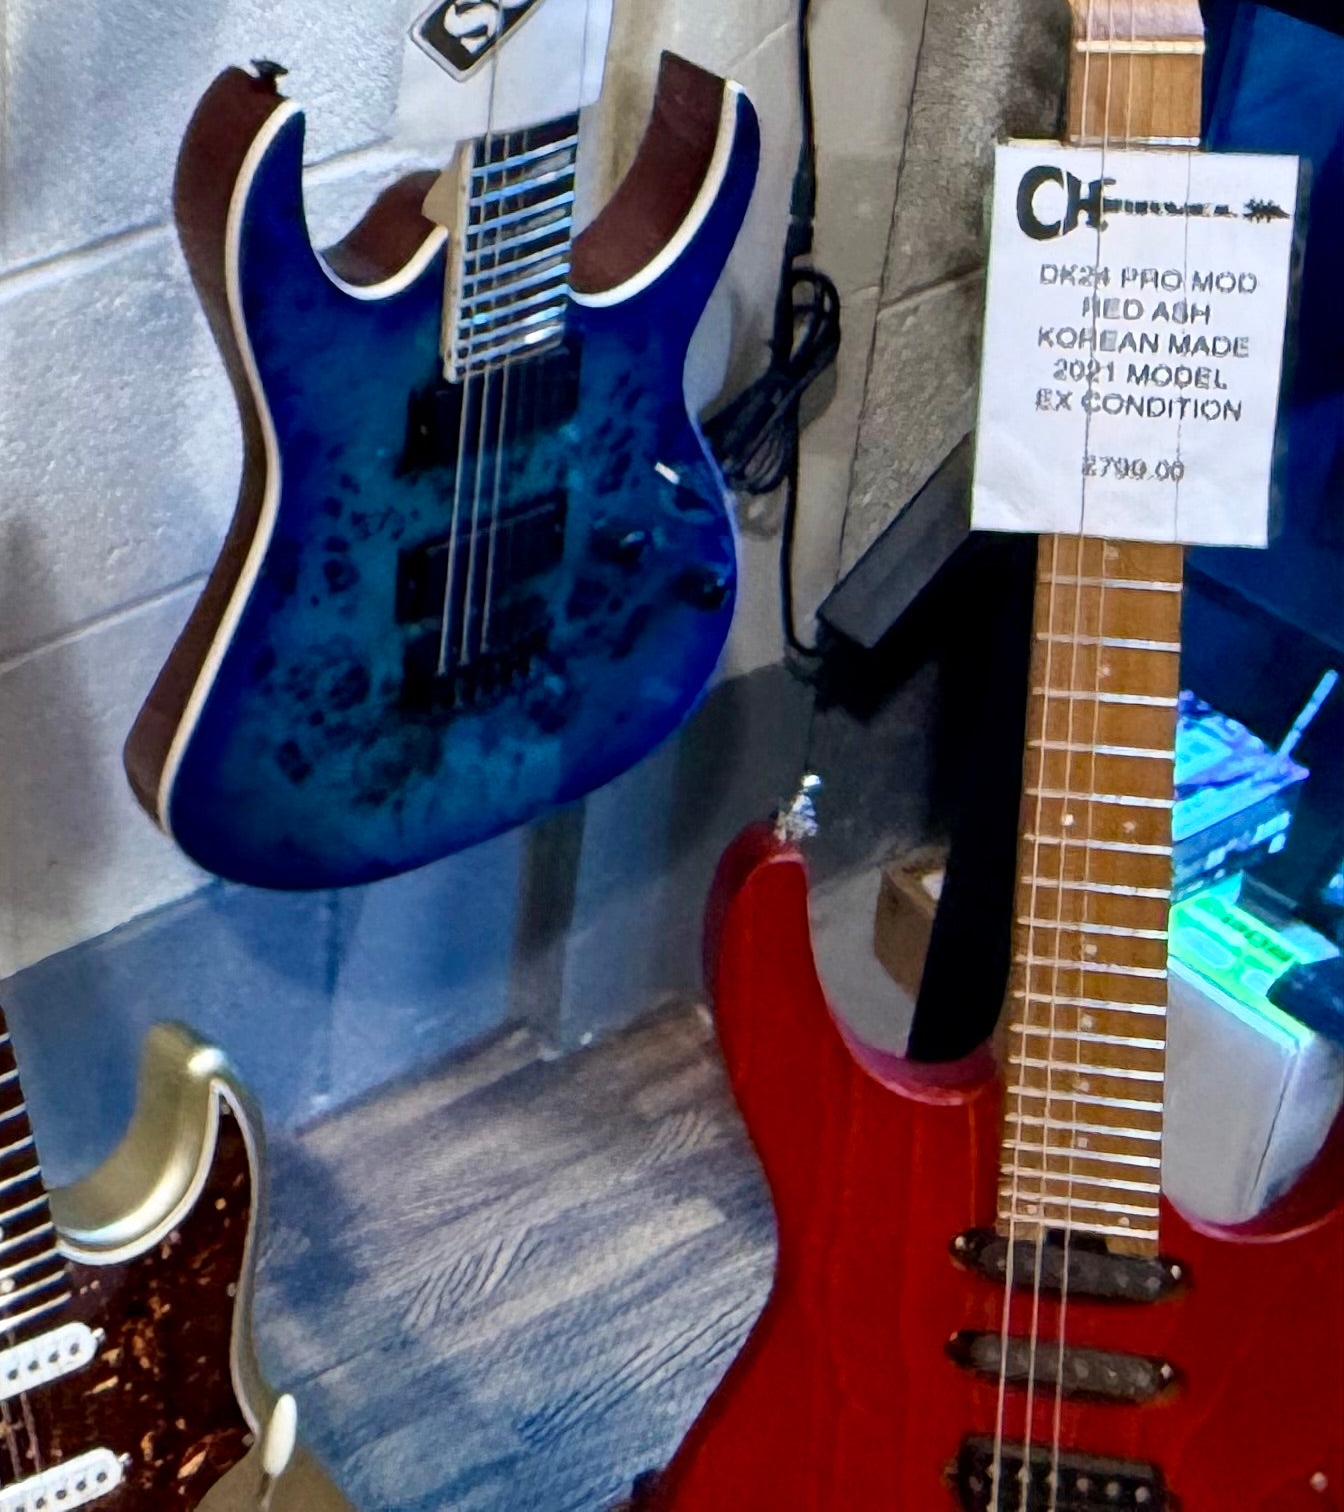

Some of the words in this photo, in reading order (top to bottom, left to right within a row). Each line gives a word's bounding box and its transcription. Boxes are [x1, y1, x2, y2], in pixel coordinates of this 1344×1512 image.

[1121, 267, 1183, 291] PRO
[1192, 271, 1258, 294] MOD
[1082, 298, 1144, 321] RED
[1152, 301, 1211, 326] ASH
[1037, 326, 1160, 354] KOREAN
[1168, 333, 1250, 359] MADE
[1053, 358, 1116, 383] 2021
[1126, 364, 1228, 390] MODEL
[1035, 388, 1073, 411] EX
[1081, 390, 1243, 422] CONDITION
